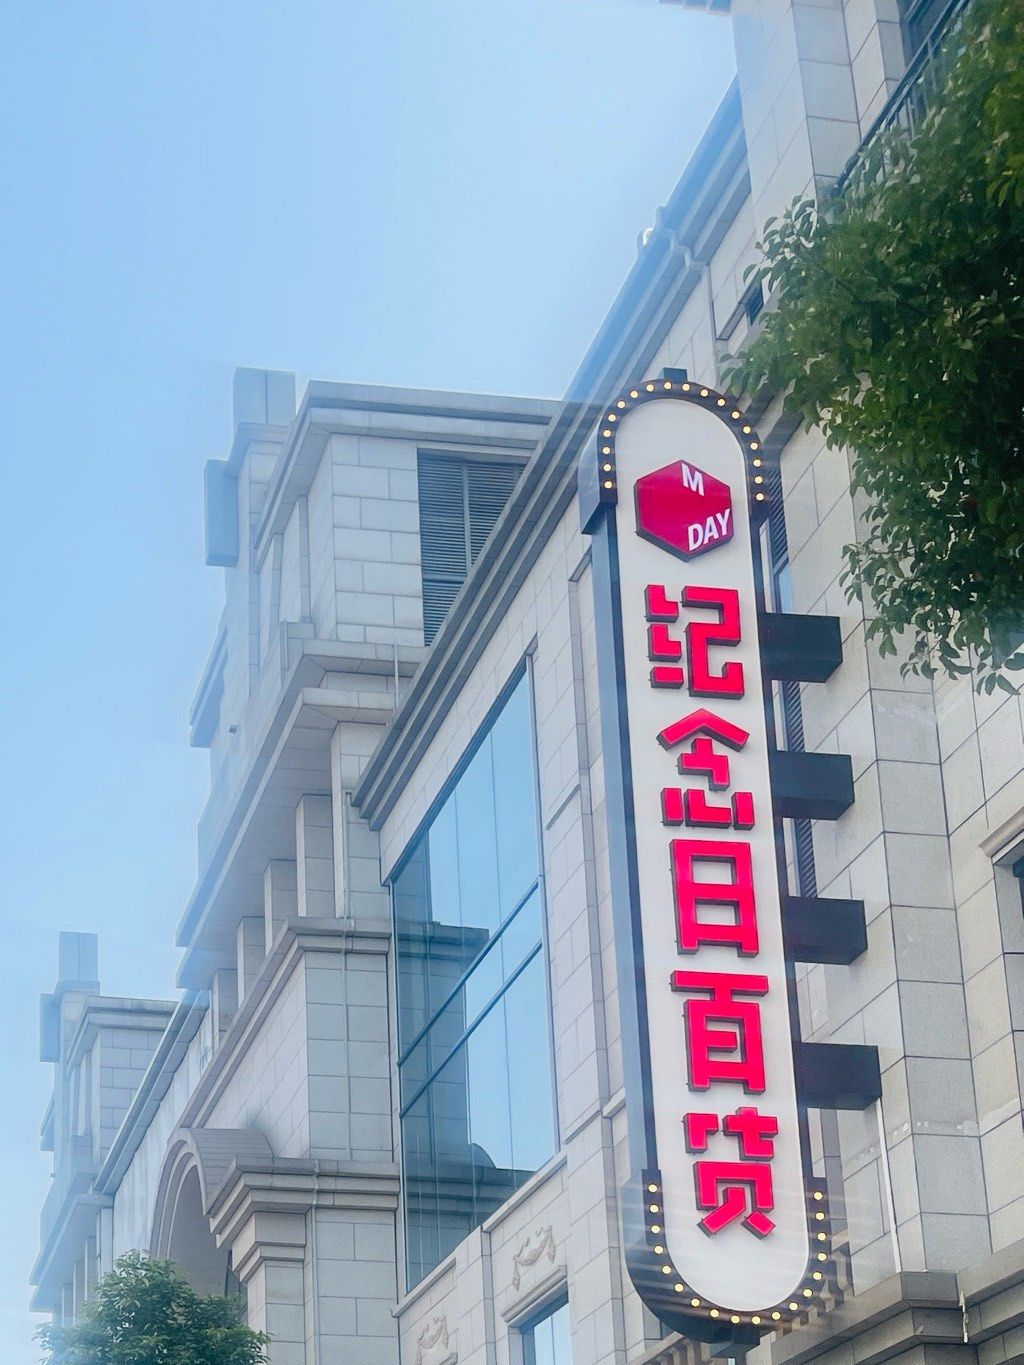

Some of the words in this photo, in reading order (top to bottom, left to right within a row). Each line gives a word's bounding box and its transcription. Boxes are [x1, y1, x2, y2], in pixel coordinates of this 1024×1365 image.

[681, 463, 705, 497] M
[687, 508, 731, 552] DAY
[644, 584, 778, 1238] 纪念日百货
